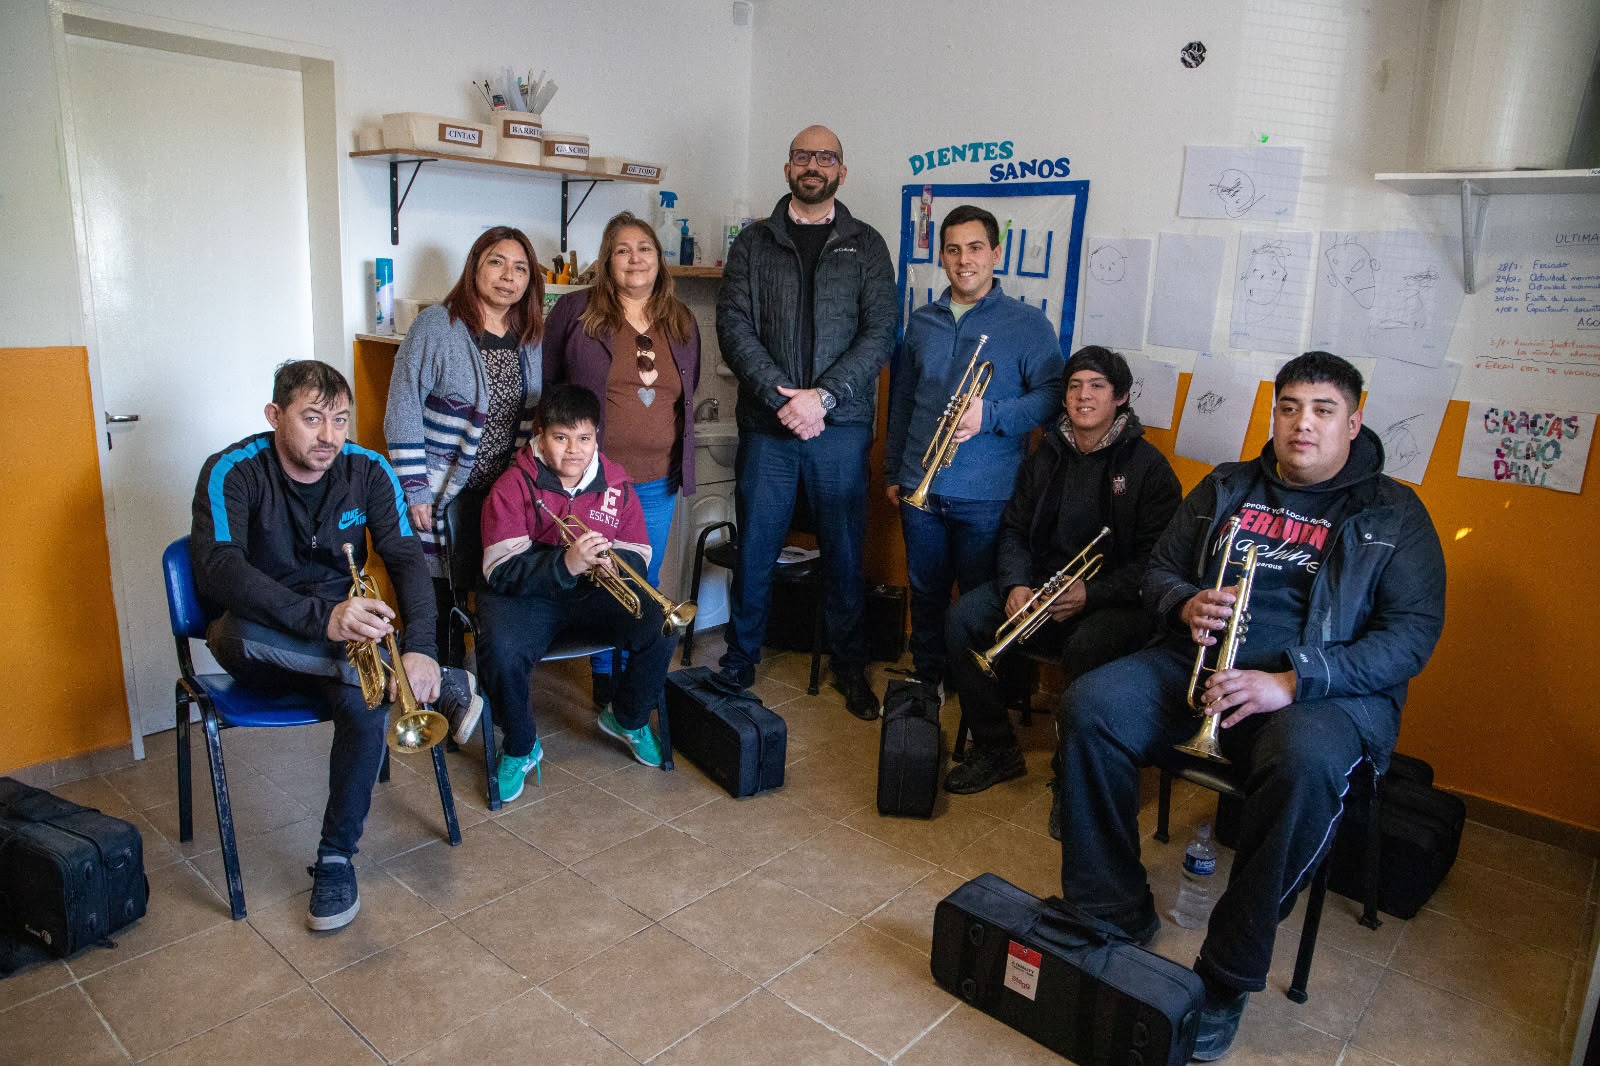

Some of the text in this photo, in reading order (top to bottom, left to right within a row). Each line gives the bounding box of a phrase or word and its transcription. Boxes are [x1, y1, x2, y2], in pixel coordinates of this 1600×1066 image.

[448, 129, 477, 141] CINTAS
[908, 141, 1014, 176] DIENTES
[639, 167, 656, 176] TODO
[989, 157, 1071, 182] SANOS
[601, 486, 622, 517] E
[341, 507, 360, 522] NIKE
[1285, 509, 1309, 522] LOCAL
